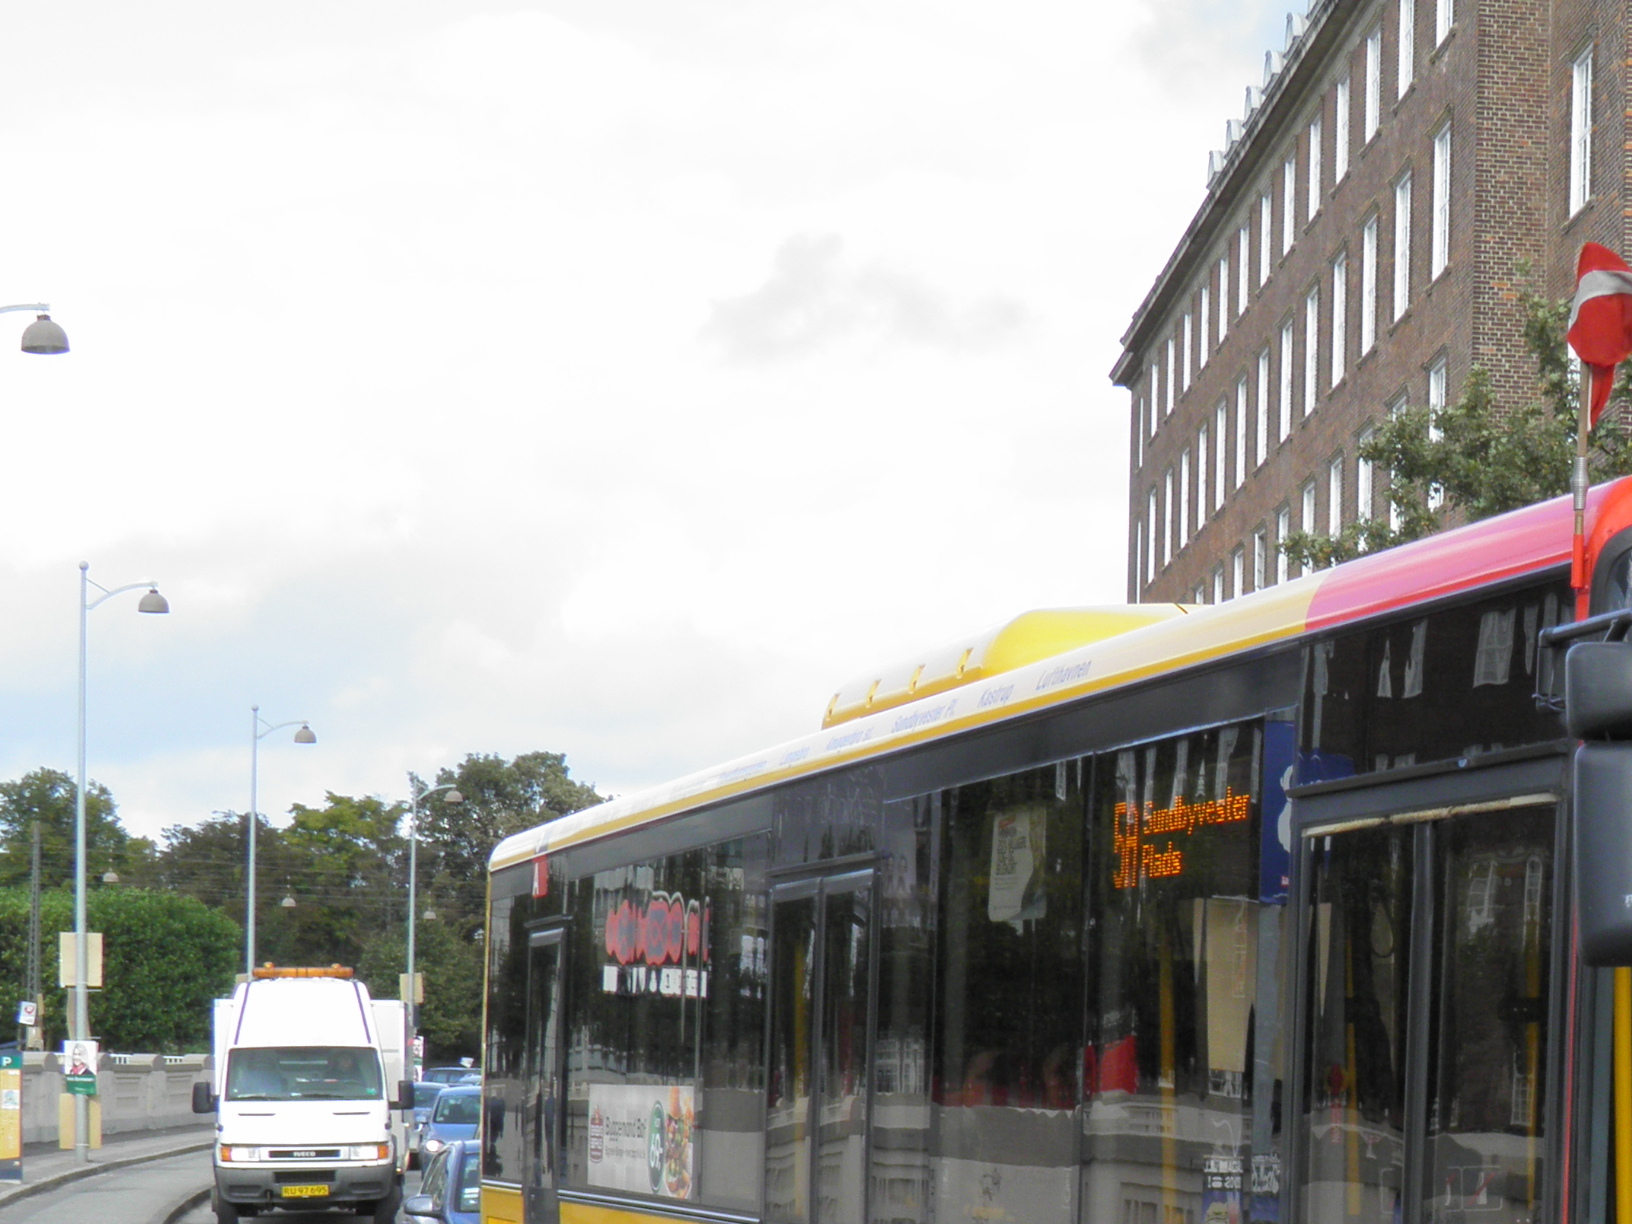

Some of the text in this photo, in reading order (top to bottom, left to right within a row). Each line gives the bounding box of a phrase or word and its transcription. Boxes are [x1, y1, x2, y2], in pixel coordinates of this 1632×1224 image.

[1143, 786, 1250, 835] Sundbyvester
[1113, 801, 1139, 888] 5A
[1141, 841, 1182, 878] Plads
[283, 1187, 296, 1195] RU
